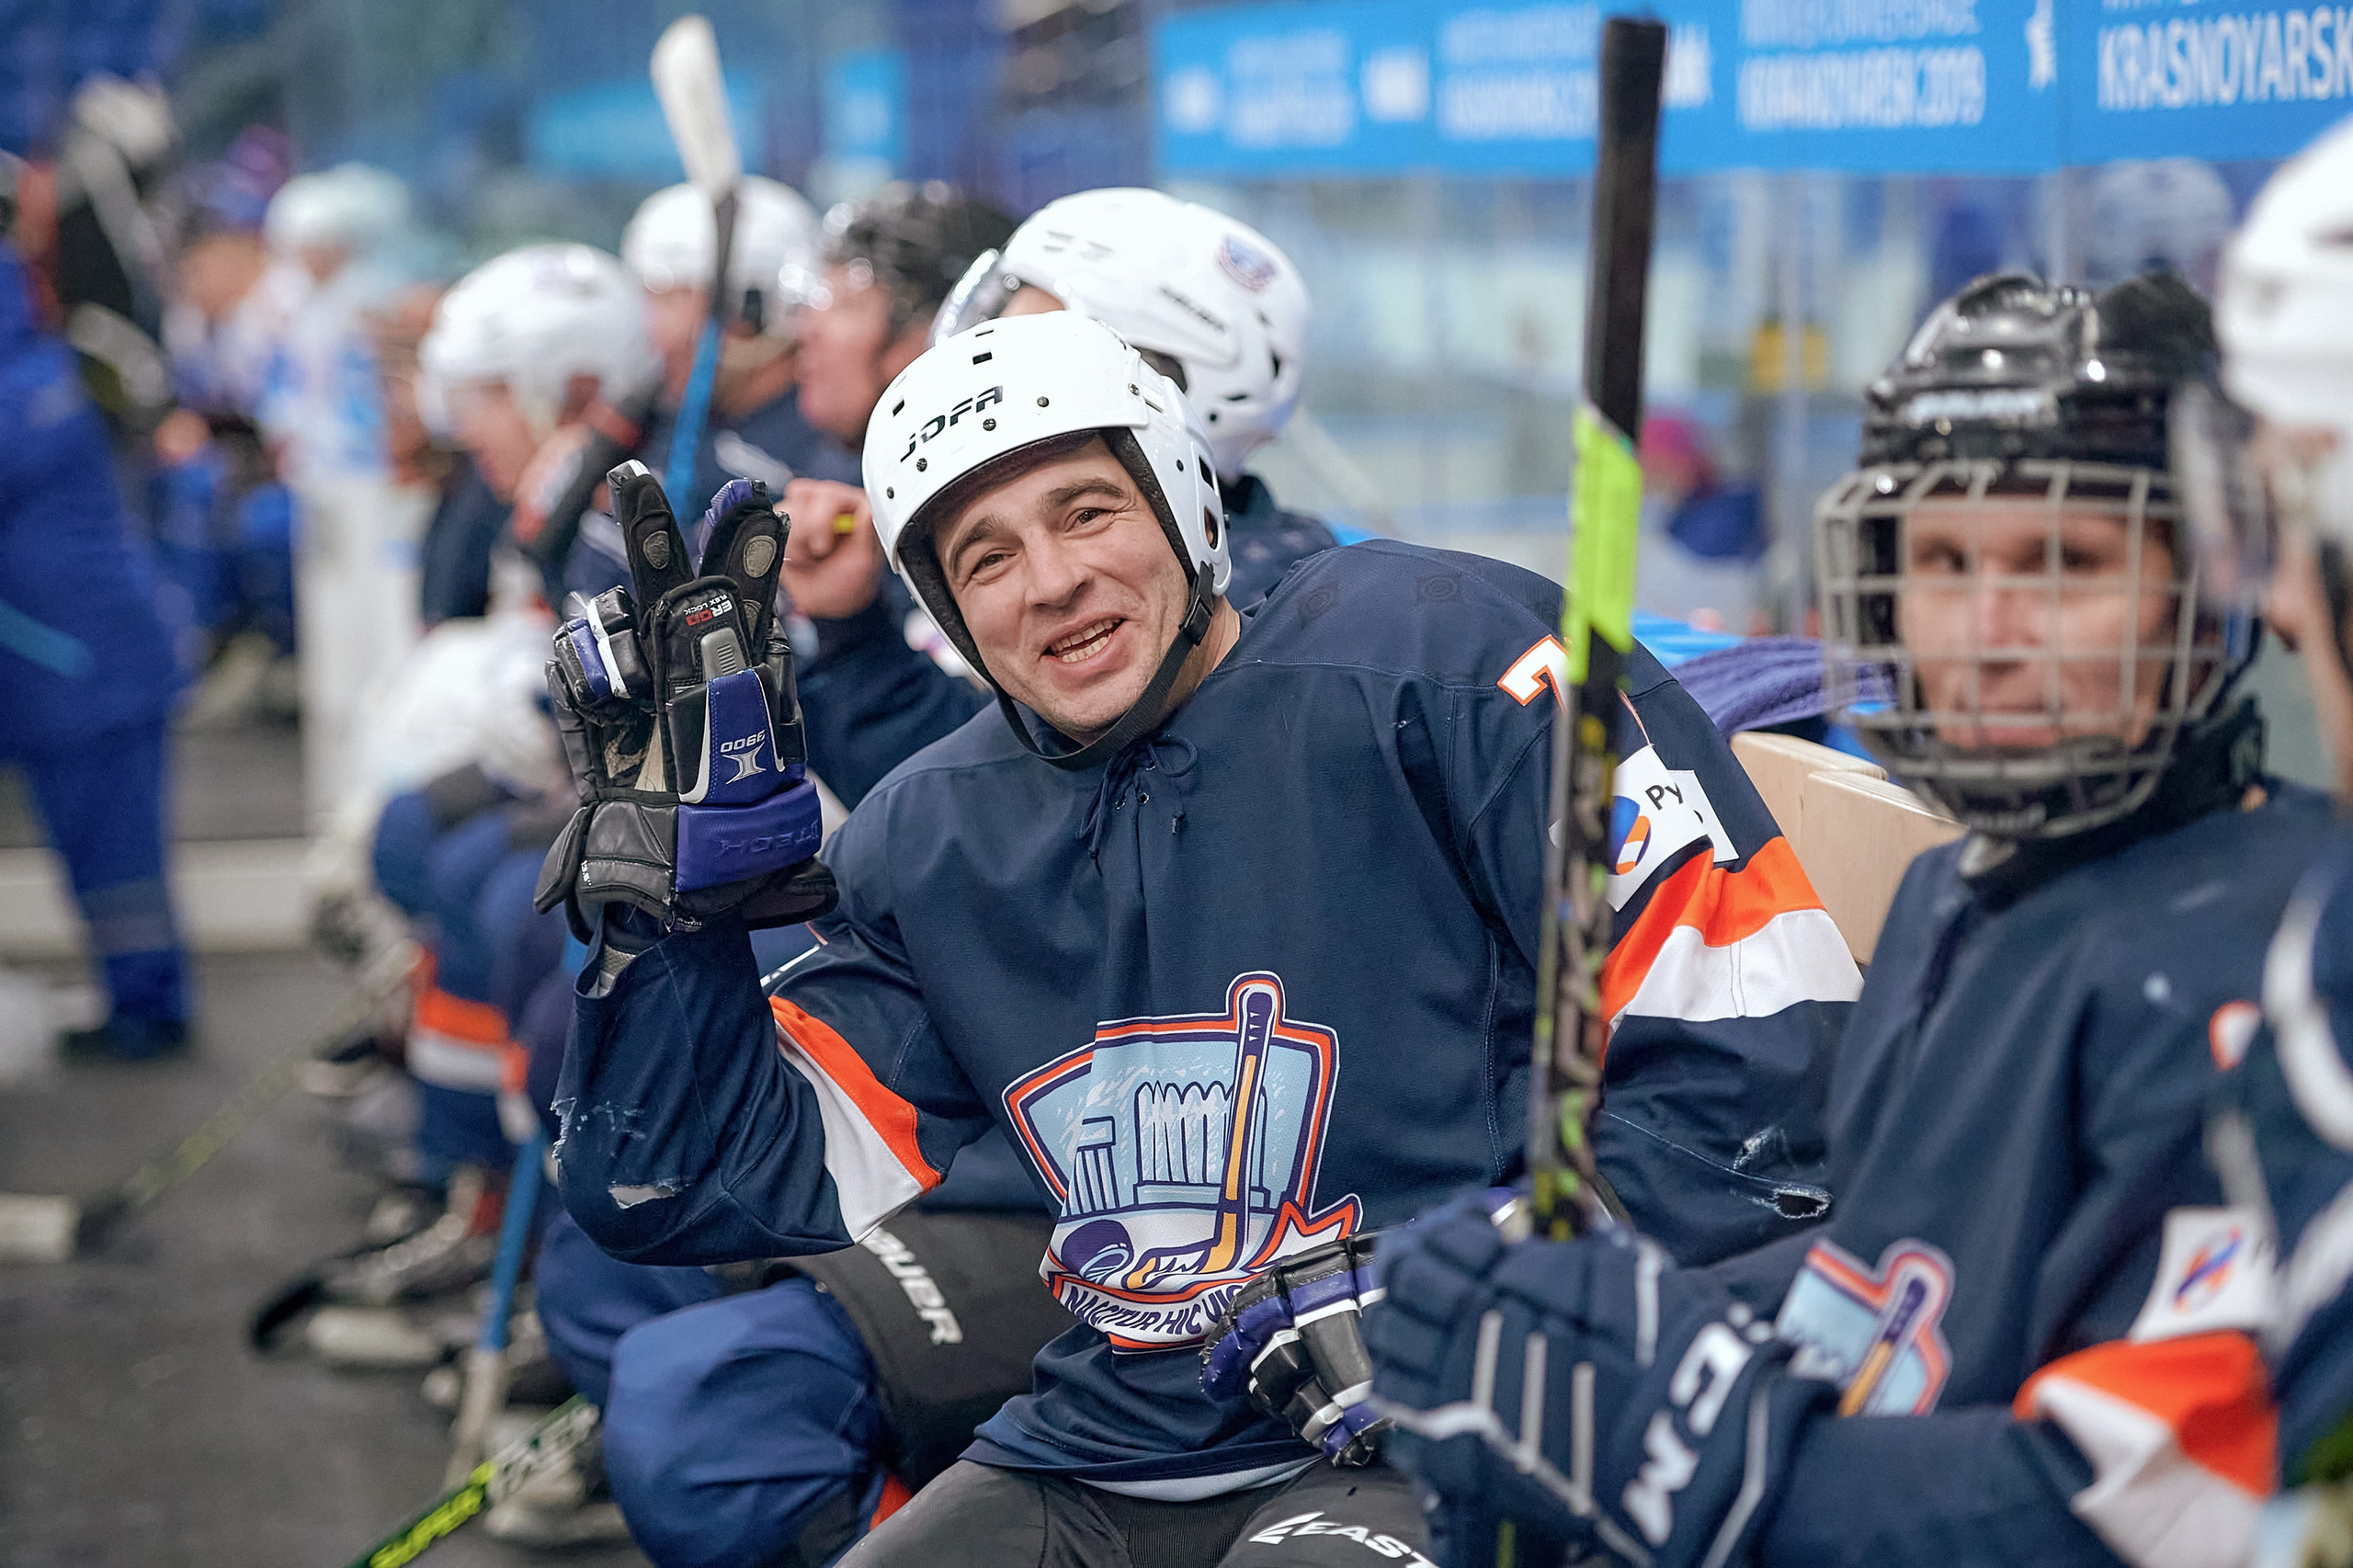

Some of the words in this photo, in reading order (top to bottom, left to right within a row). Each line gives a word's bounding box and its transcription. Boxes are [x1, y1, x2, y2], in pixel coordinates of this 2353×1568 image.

[901, 385, 1003, 462] JOFA
[683, 602, 709, 615] LOCK
[686, 599, 733, 626] ERGO
[720, 729, 766, 753] 9900
[860, 1226, 963, 1346] AUER
[1154, 1303, 1202, 1335] HIC
[1621, 1305, 1767, 1548] CM
